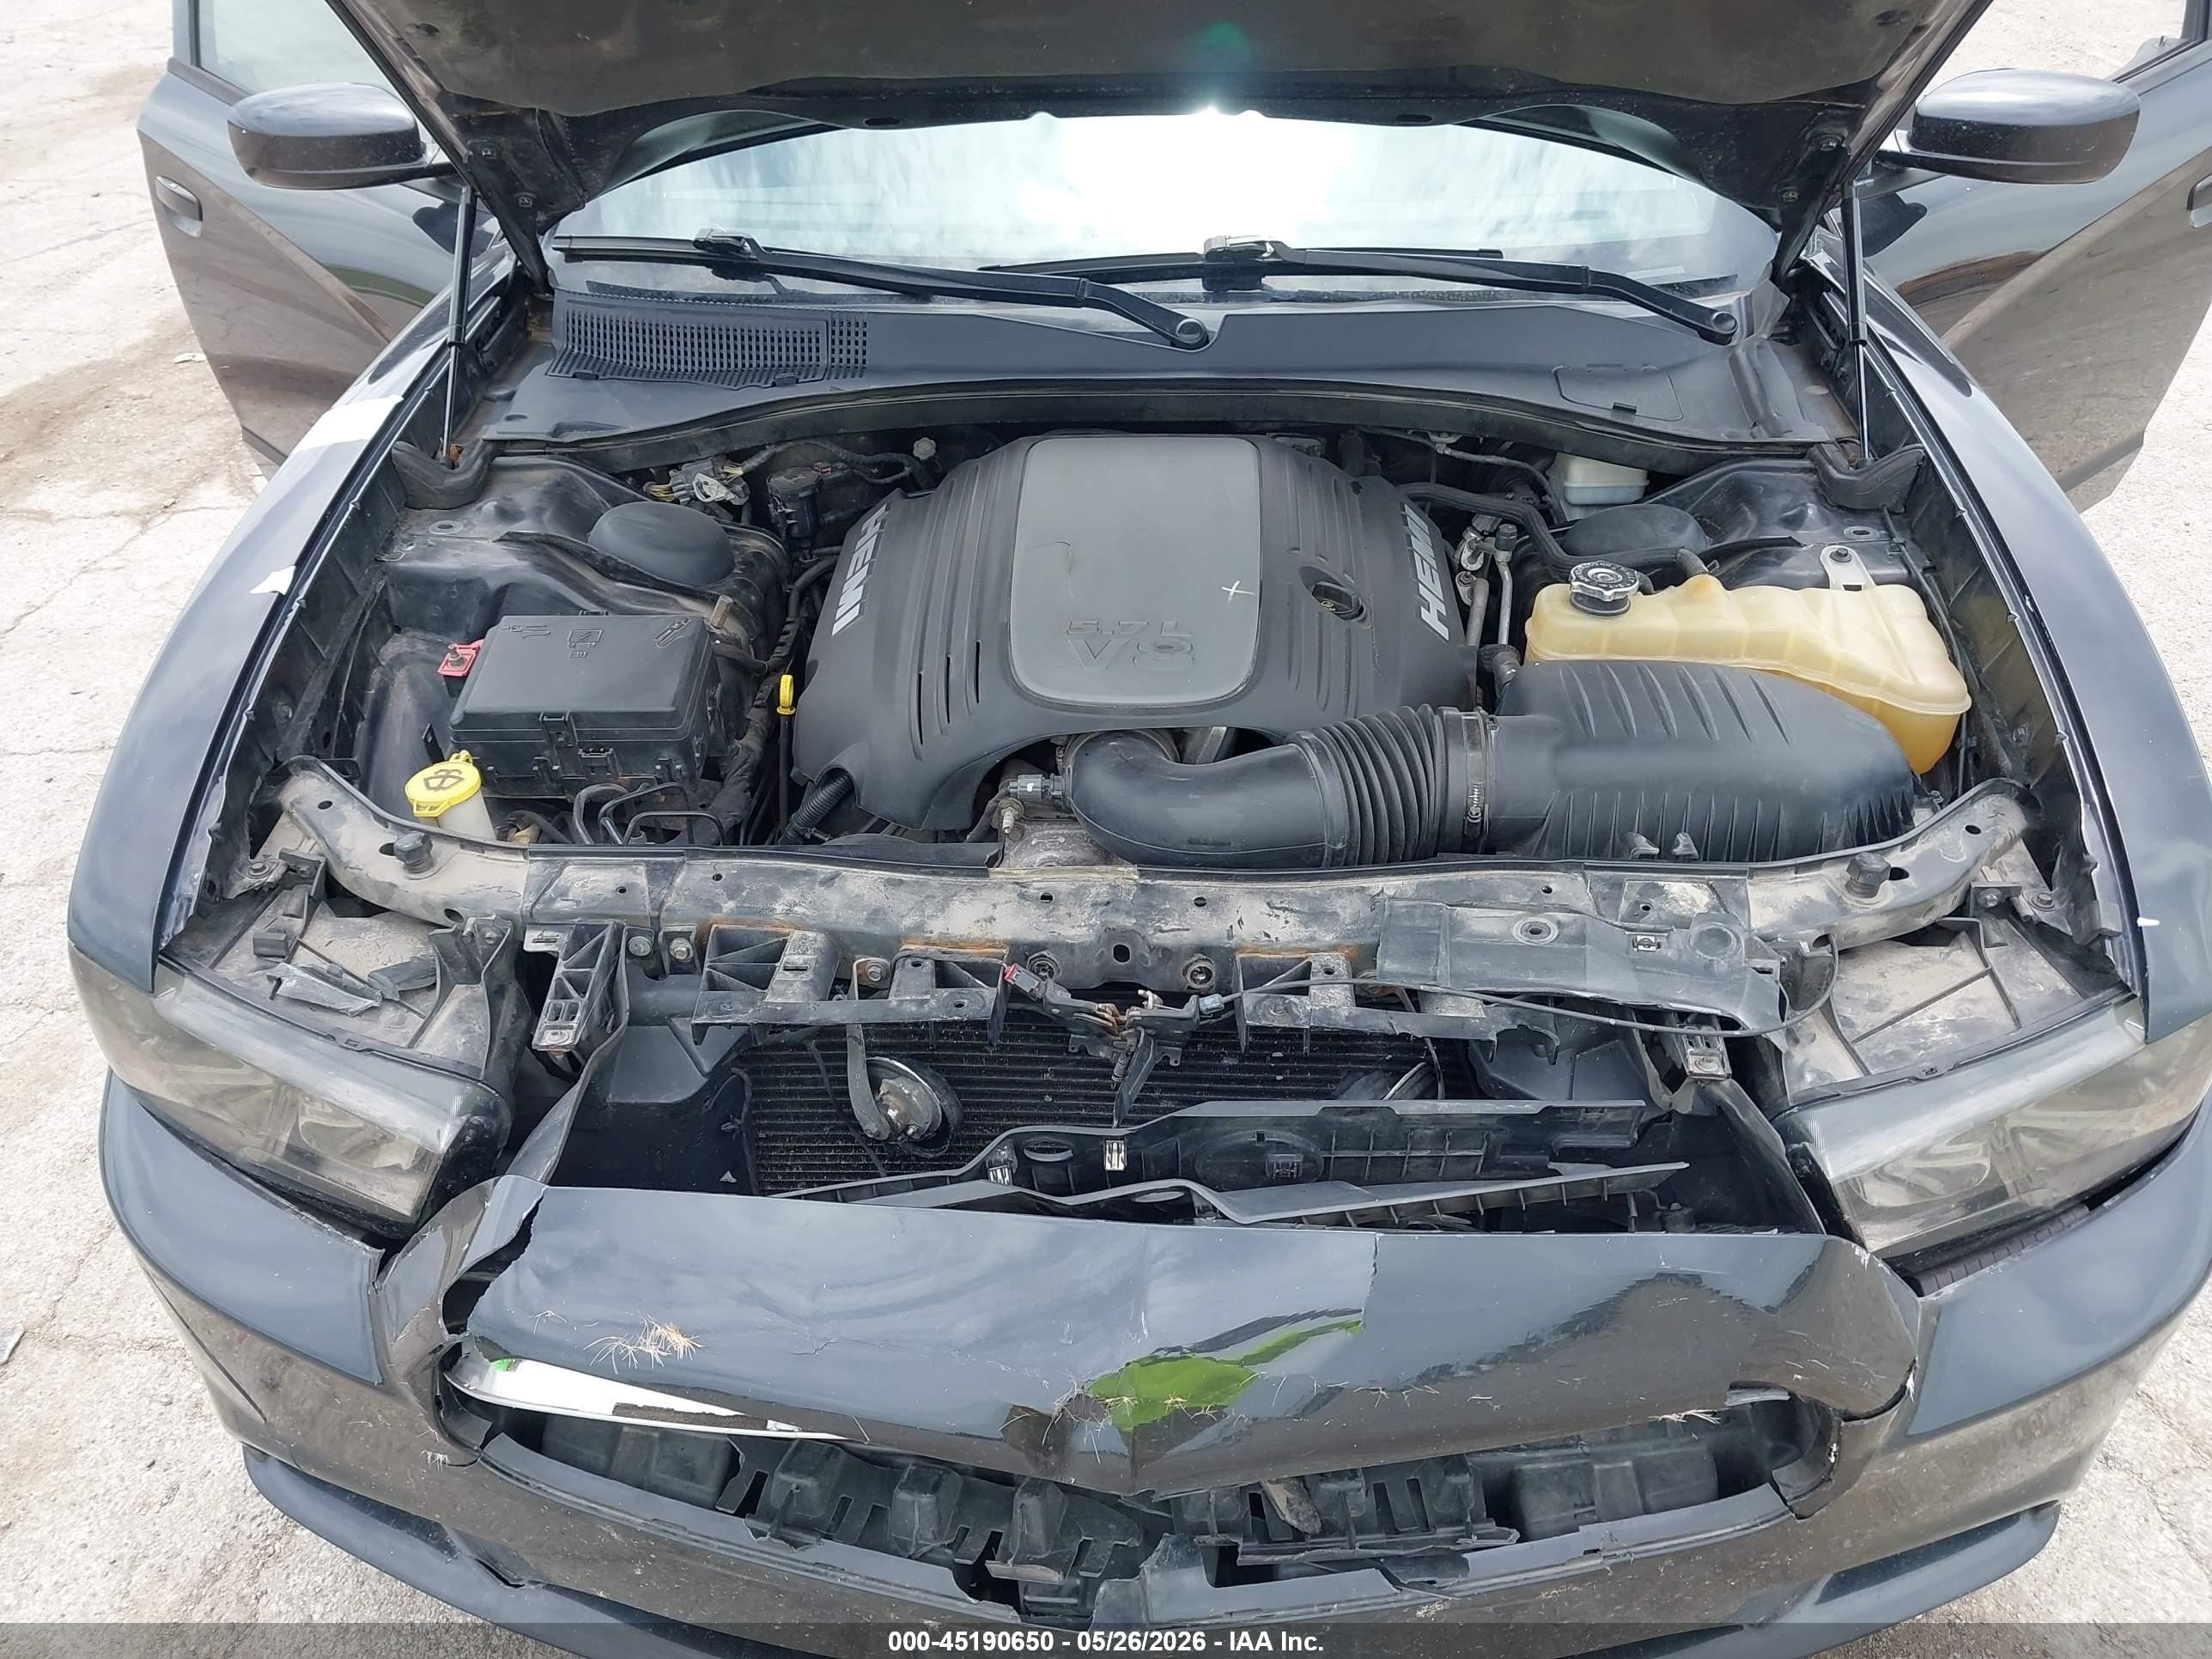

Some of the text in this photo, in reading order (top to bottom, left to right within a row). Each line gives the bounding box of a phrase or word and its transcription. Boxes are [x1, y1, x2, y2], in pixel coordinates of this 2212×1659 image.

[831, 502, 888, 637] HEMI
[1403, 502, 1450, 641] HEMI
[1064, 637, 1196, 672] V8
